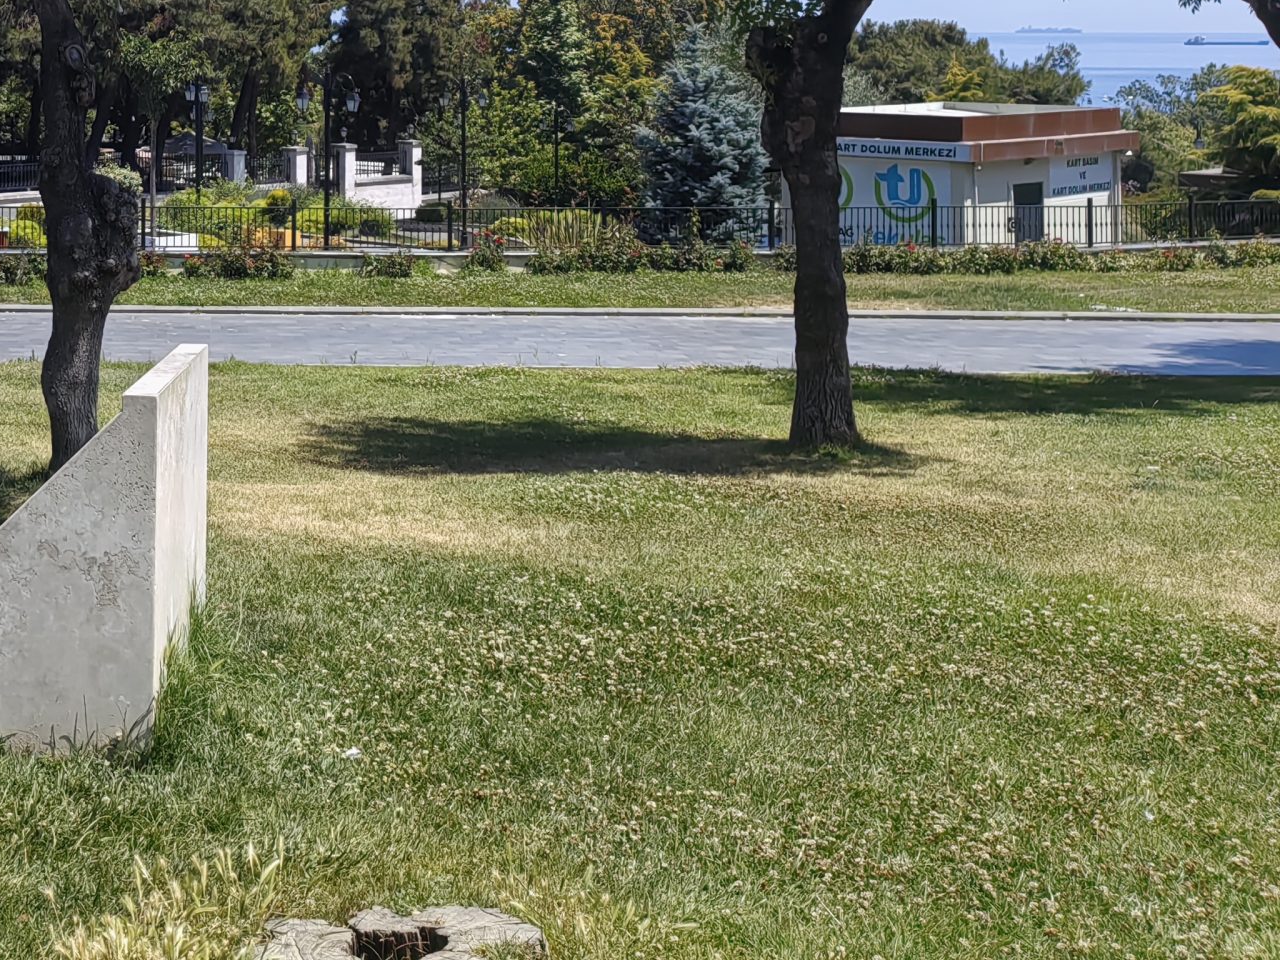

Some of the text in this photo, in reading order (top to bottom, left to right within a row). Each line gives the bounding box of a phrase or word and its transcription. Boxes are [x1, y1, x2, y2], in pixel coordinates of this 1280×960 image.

[836, 143, 957, 158] ART DOLUM MERKEZİ
[1079, 170, 1087, 180] VE
